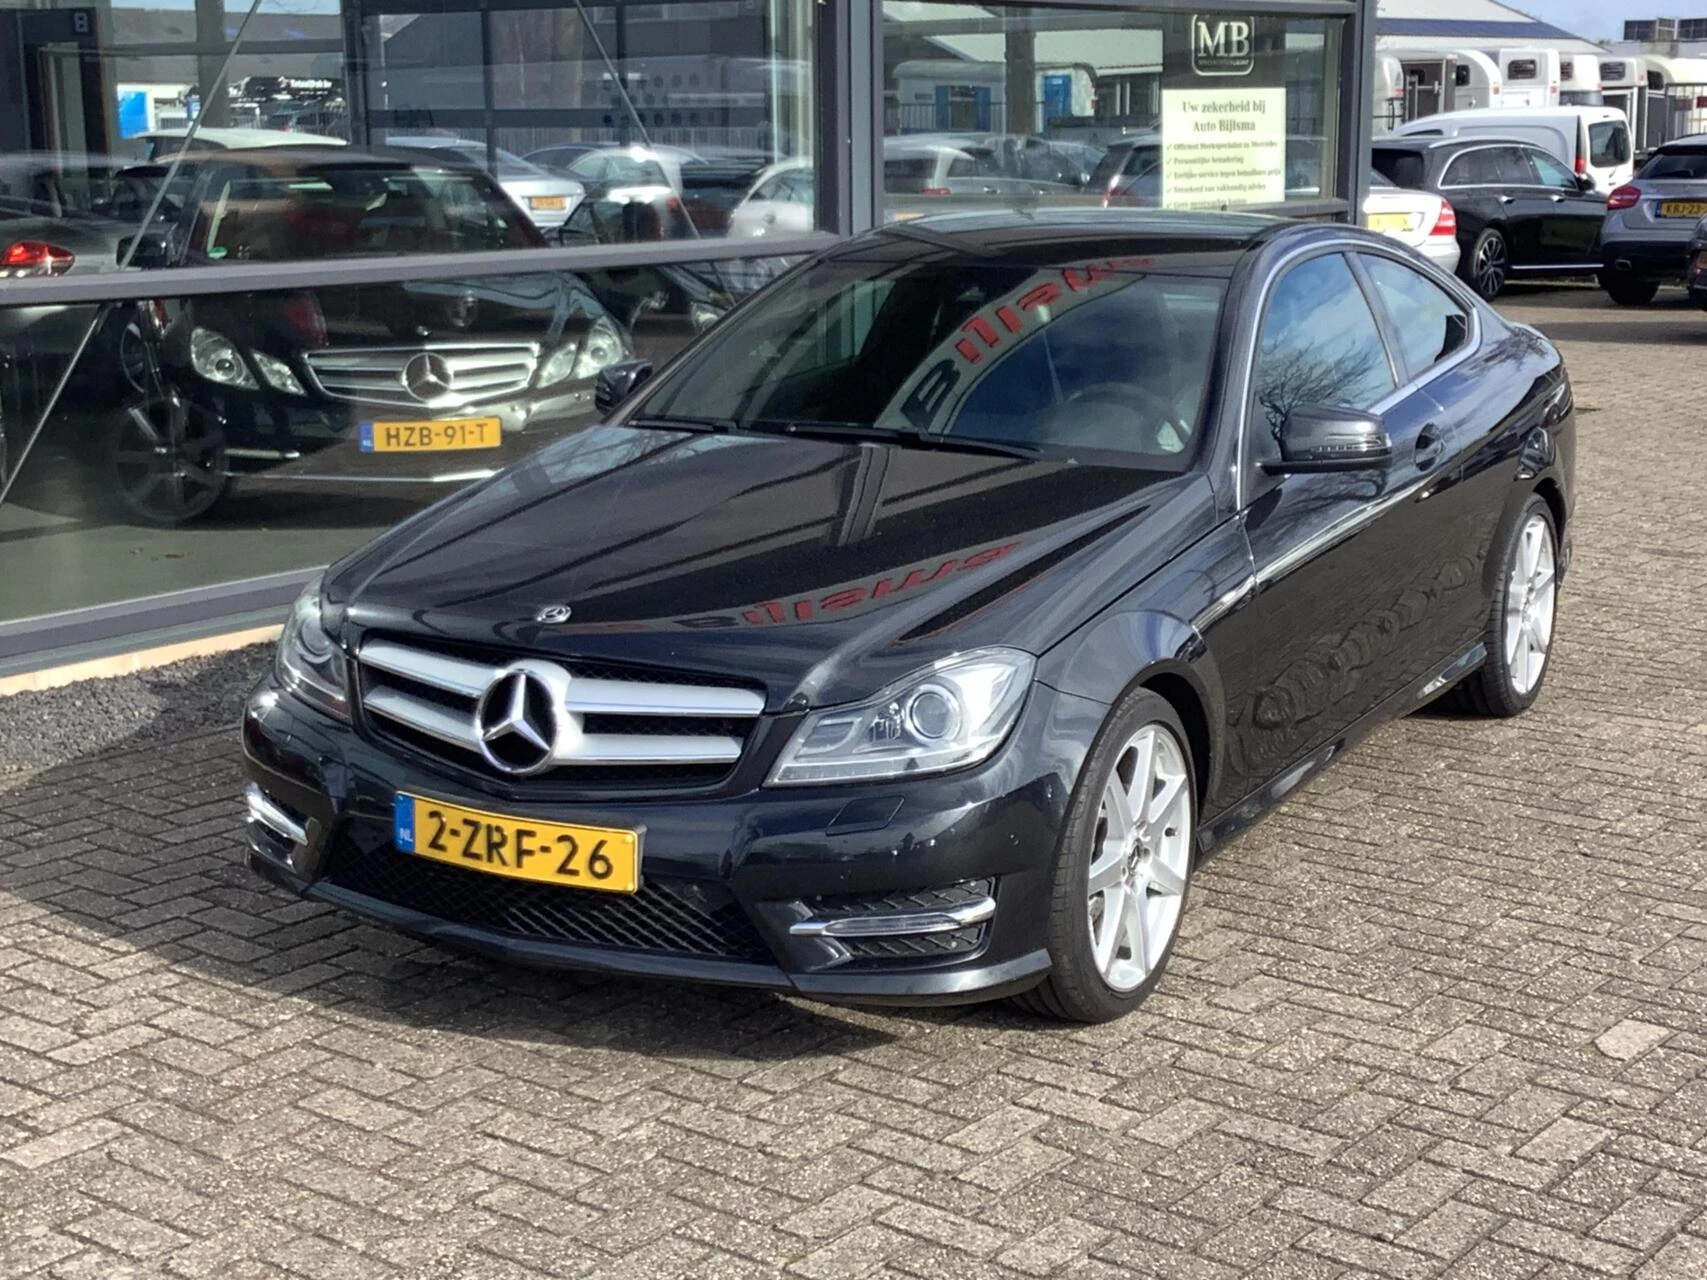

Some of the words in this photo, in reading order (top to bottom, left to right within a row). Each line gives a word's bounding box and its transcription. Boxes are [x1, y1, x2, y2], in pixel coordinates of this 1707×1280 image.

[1197, 21, 1250, 57] MB
[1182, 100, 1199, 112] Uw
[1201, 99, 1250, 113] zekerheid
[1252, 99, 1266, 115] bij
[1193, 120, 1217, 132] Auto
[1219, 118, 1256, 133] Bijlsma
[384, 423, 489, 448] HZB-91-T
[399, 828, 413, 842] NL
[427, 809, 614, 881] 2-ZRF-26
